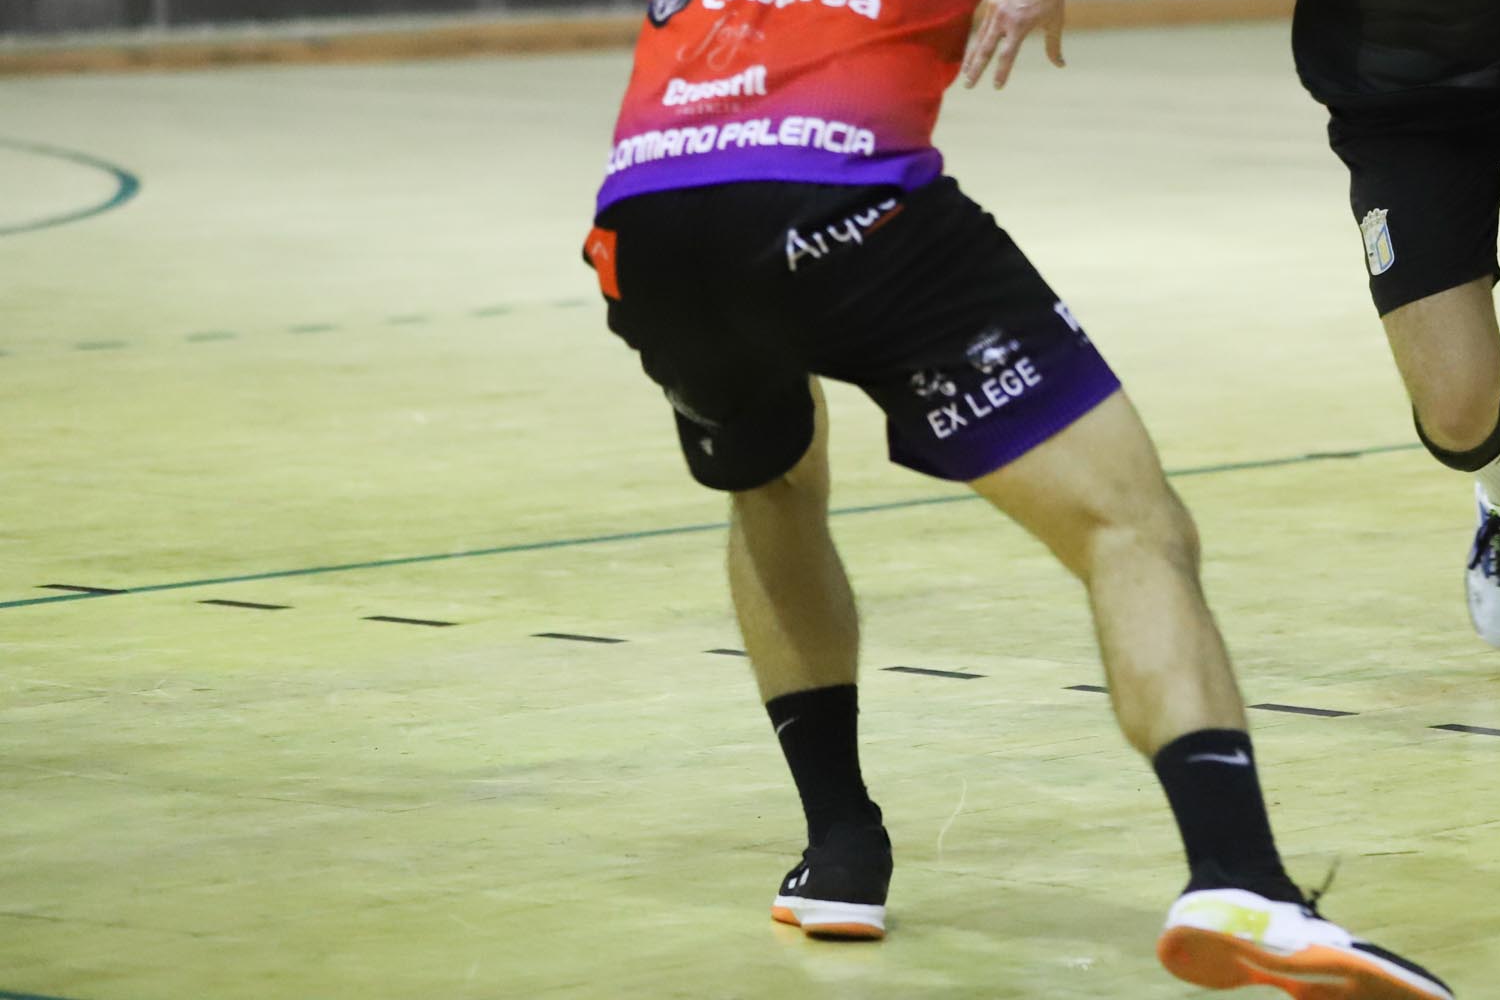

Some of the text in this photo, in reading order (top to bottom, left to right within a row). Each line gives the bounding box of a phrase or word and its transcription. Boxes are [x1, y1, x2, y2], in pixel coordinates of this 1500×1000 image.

[716, 115, 875, 156] PALENCIA
[926, 356, 1043, 439] EX LEGE
